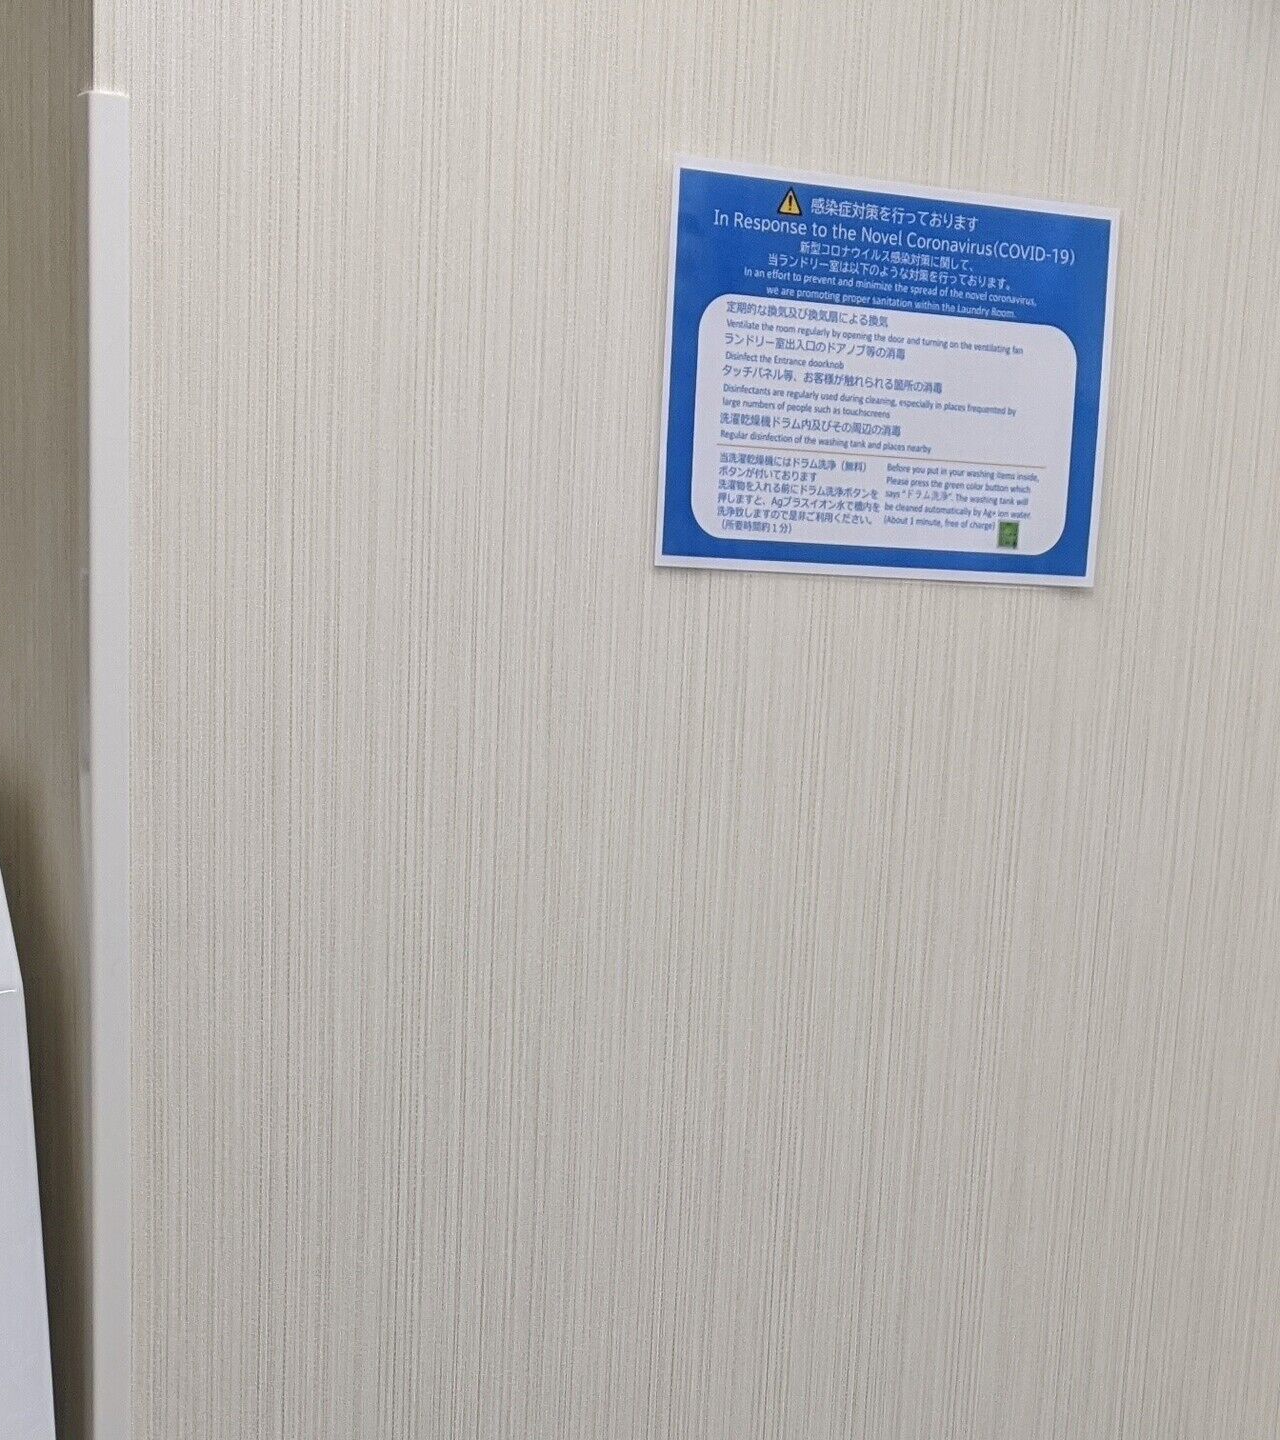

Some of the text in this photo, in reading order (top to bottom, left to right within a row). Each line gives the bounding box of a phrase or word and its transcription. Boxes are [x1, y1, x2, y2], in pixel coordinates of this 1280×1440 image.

[811, 198, 979, 232] 感染症対策を行っております
[714, 209, 1076, 267] In Response to the Novel Coronavirus(COVID-19)
[800, 241, 974, 272] 新型コロナウイルス感染対策に関して、
[744, 267, 752, 276] In
[766, 269, 791, 281] effort
[803, 274, 836, 287] prevent
[838, 276, 854, 287] and
[856, 278, 892, 291] minimize
[895, 282, 909, 293] the
[910, 284, 937, 297] spread
[950, 288, 963, 299] the
[965, 289, 987, 301] novel
[768, 253, 1011, 291] 当ランドリー室は以下のような対策を行っております。
[726, 301, 889, 328] 定期的な換気及び換気扇による換気
[781, 287, 795, 297] are
[797, 288, 840, 303] promoting
[842, 292, 870, 306] proper
[872, 295, 912, 308] sanitation
[915, 300, 940, 311] within
[941, 302, 955, 313] the
[957, 304, 990, 316] Laundry
[726, 319, 830, 338] Ventilate the room regularly
[724, 332, 906, 361] ランドリー室出入口のドアノブ等の消毒
[725, 351, 845, 369] Disinfect the Entrance doorknob
[718, 466, 818, 483] ボタンが付いております
